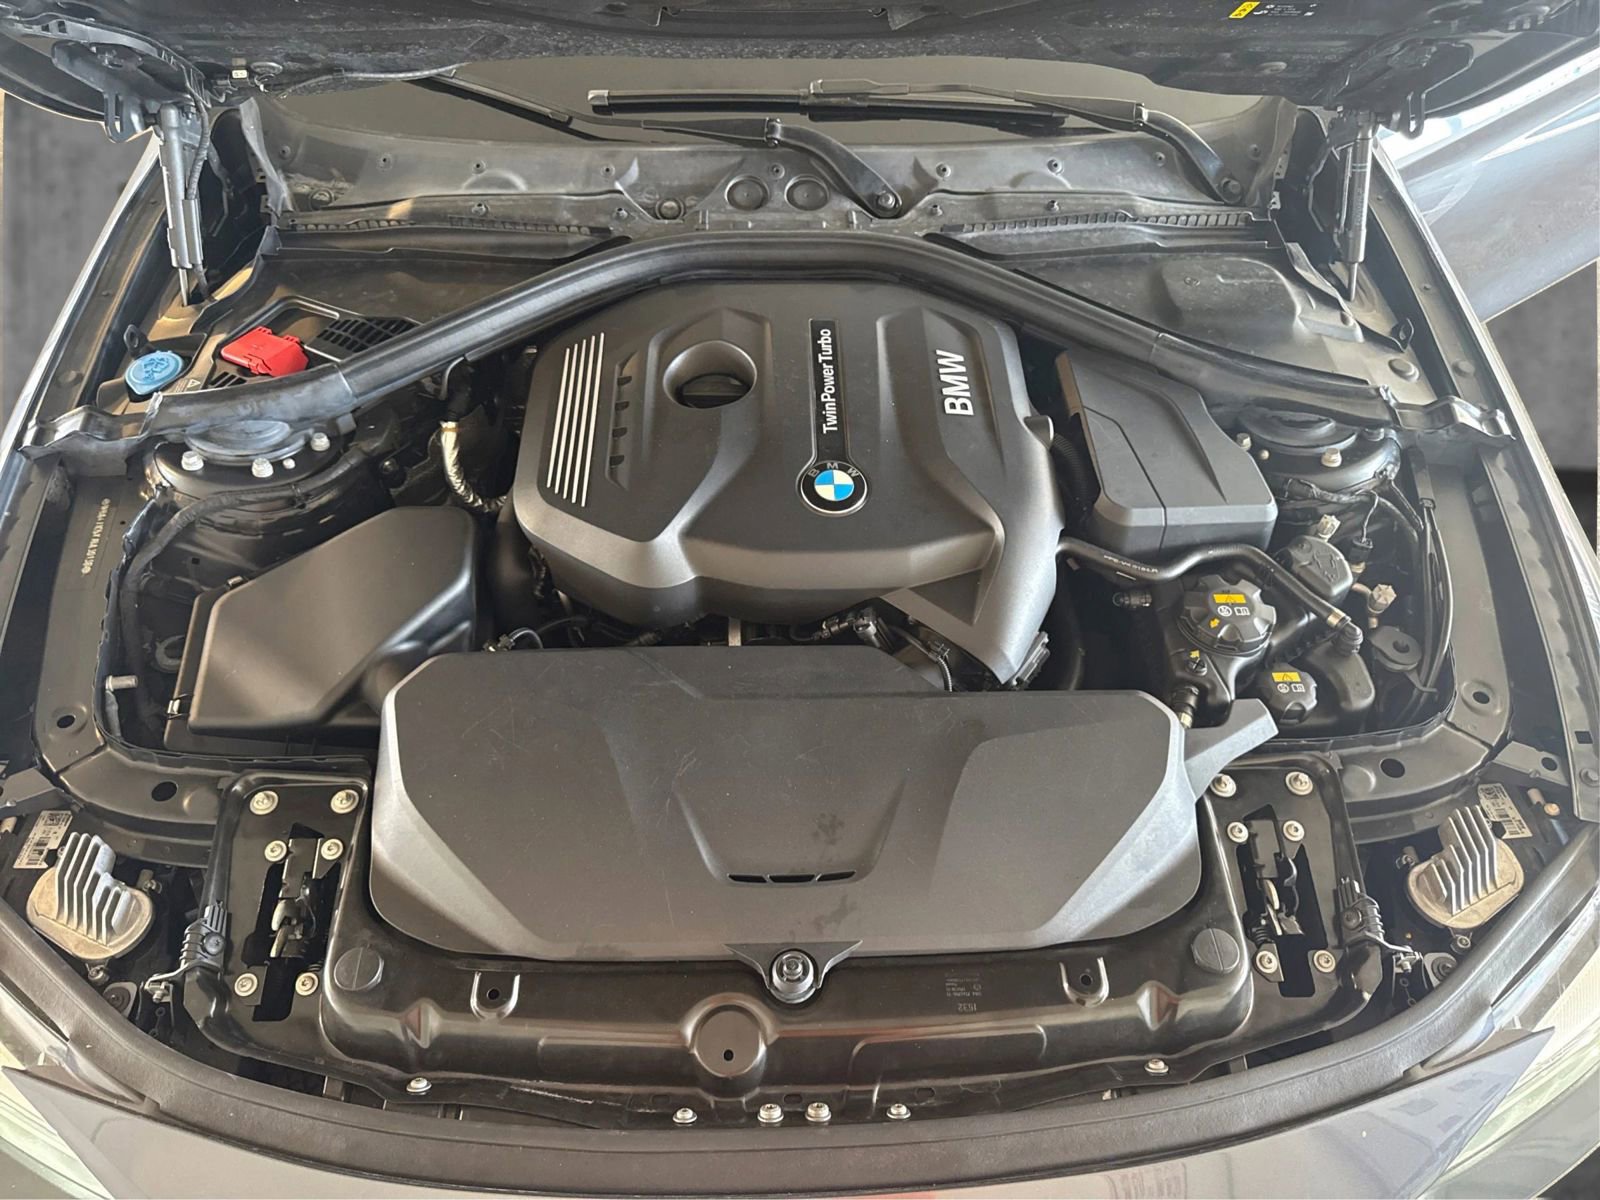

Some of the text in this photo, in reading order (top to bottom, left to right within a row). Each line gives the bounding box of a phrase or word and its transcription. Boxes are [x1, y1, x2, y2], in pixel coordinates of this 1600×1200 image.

[817, 329, 838, 434] TwinPower Turbo
[935, 349, 974, 415] BMW
[807, 462, 860, 478] BMW
